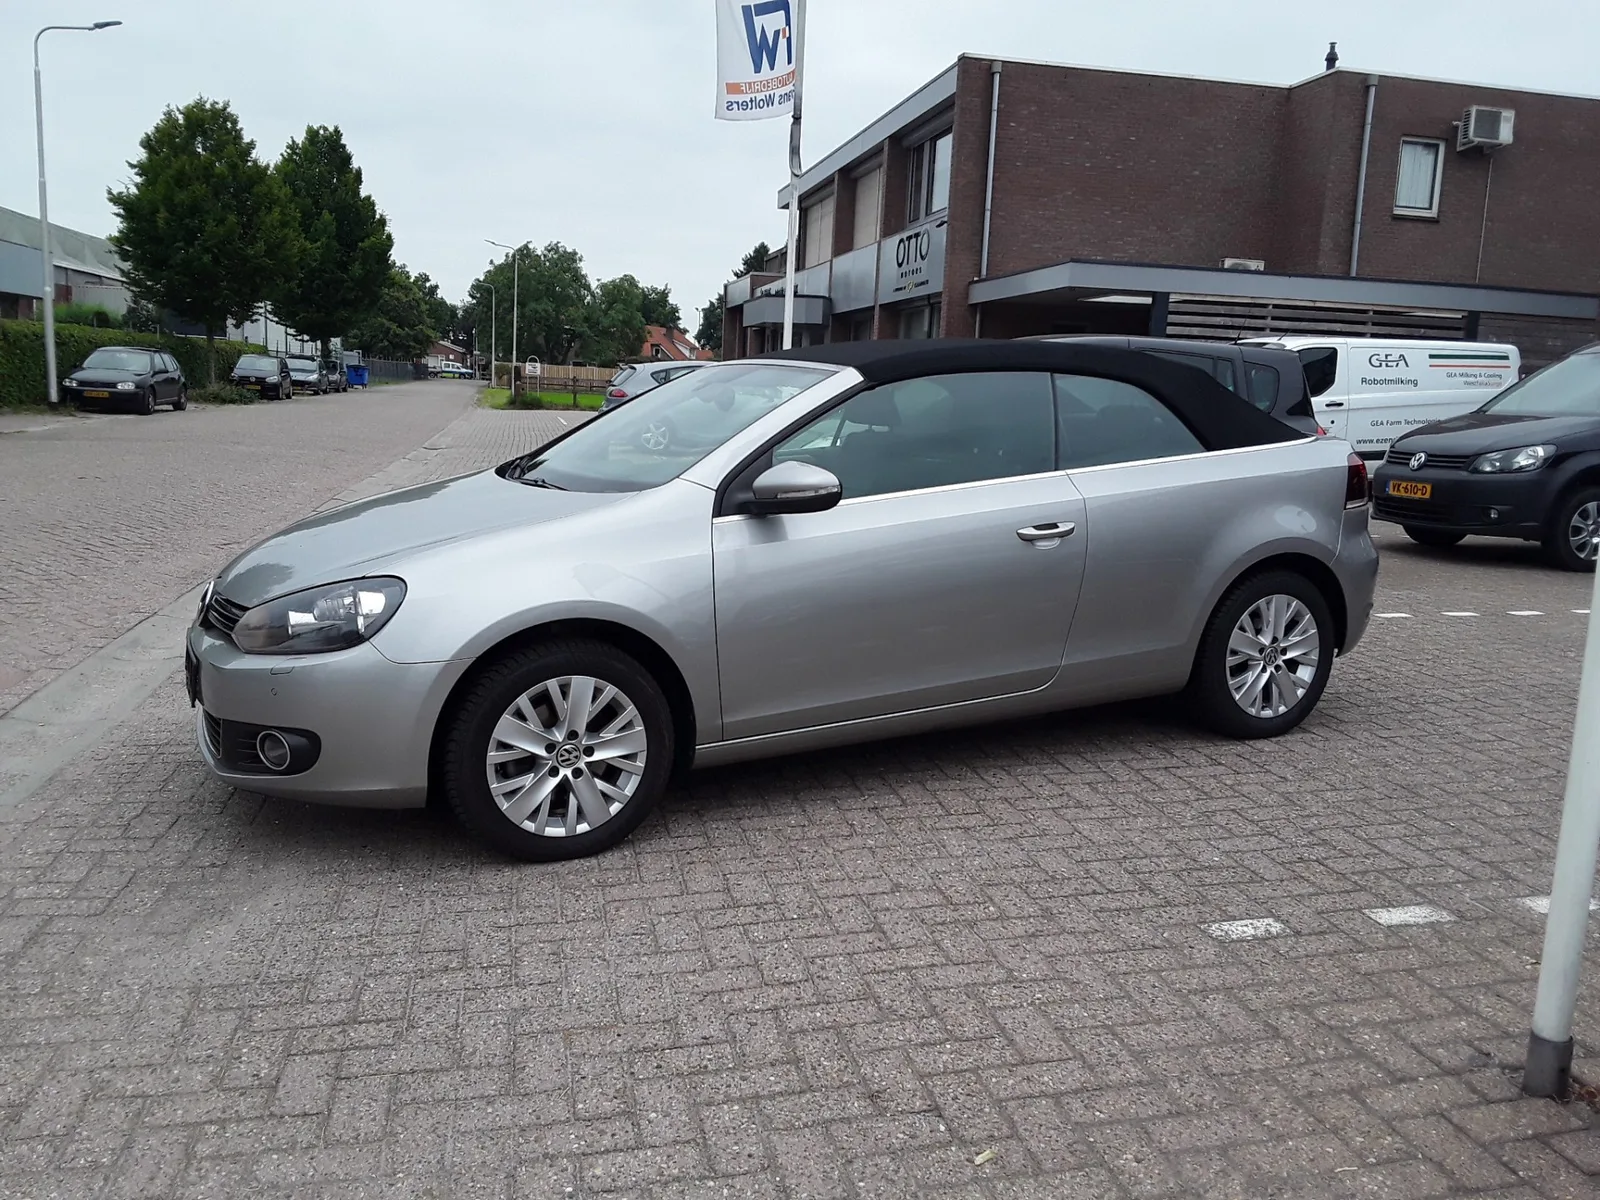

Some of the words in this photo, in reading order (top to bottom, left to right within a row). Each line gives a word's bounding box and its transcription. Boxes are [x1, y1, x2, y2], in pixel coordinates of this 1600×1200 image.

[897, 229, 930, 268] OTTO
[901, 267, 922, 279] MOTORS
[1368, 353, 1409, 368] GEA
[1361, 377, 1418, 387] Robotmilking
[1484, 372, 1502, 380] Cooling
[1392, 481, 1428, 496] VK-610-D
